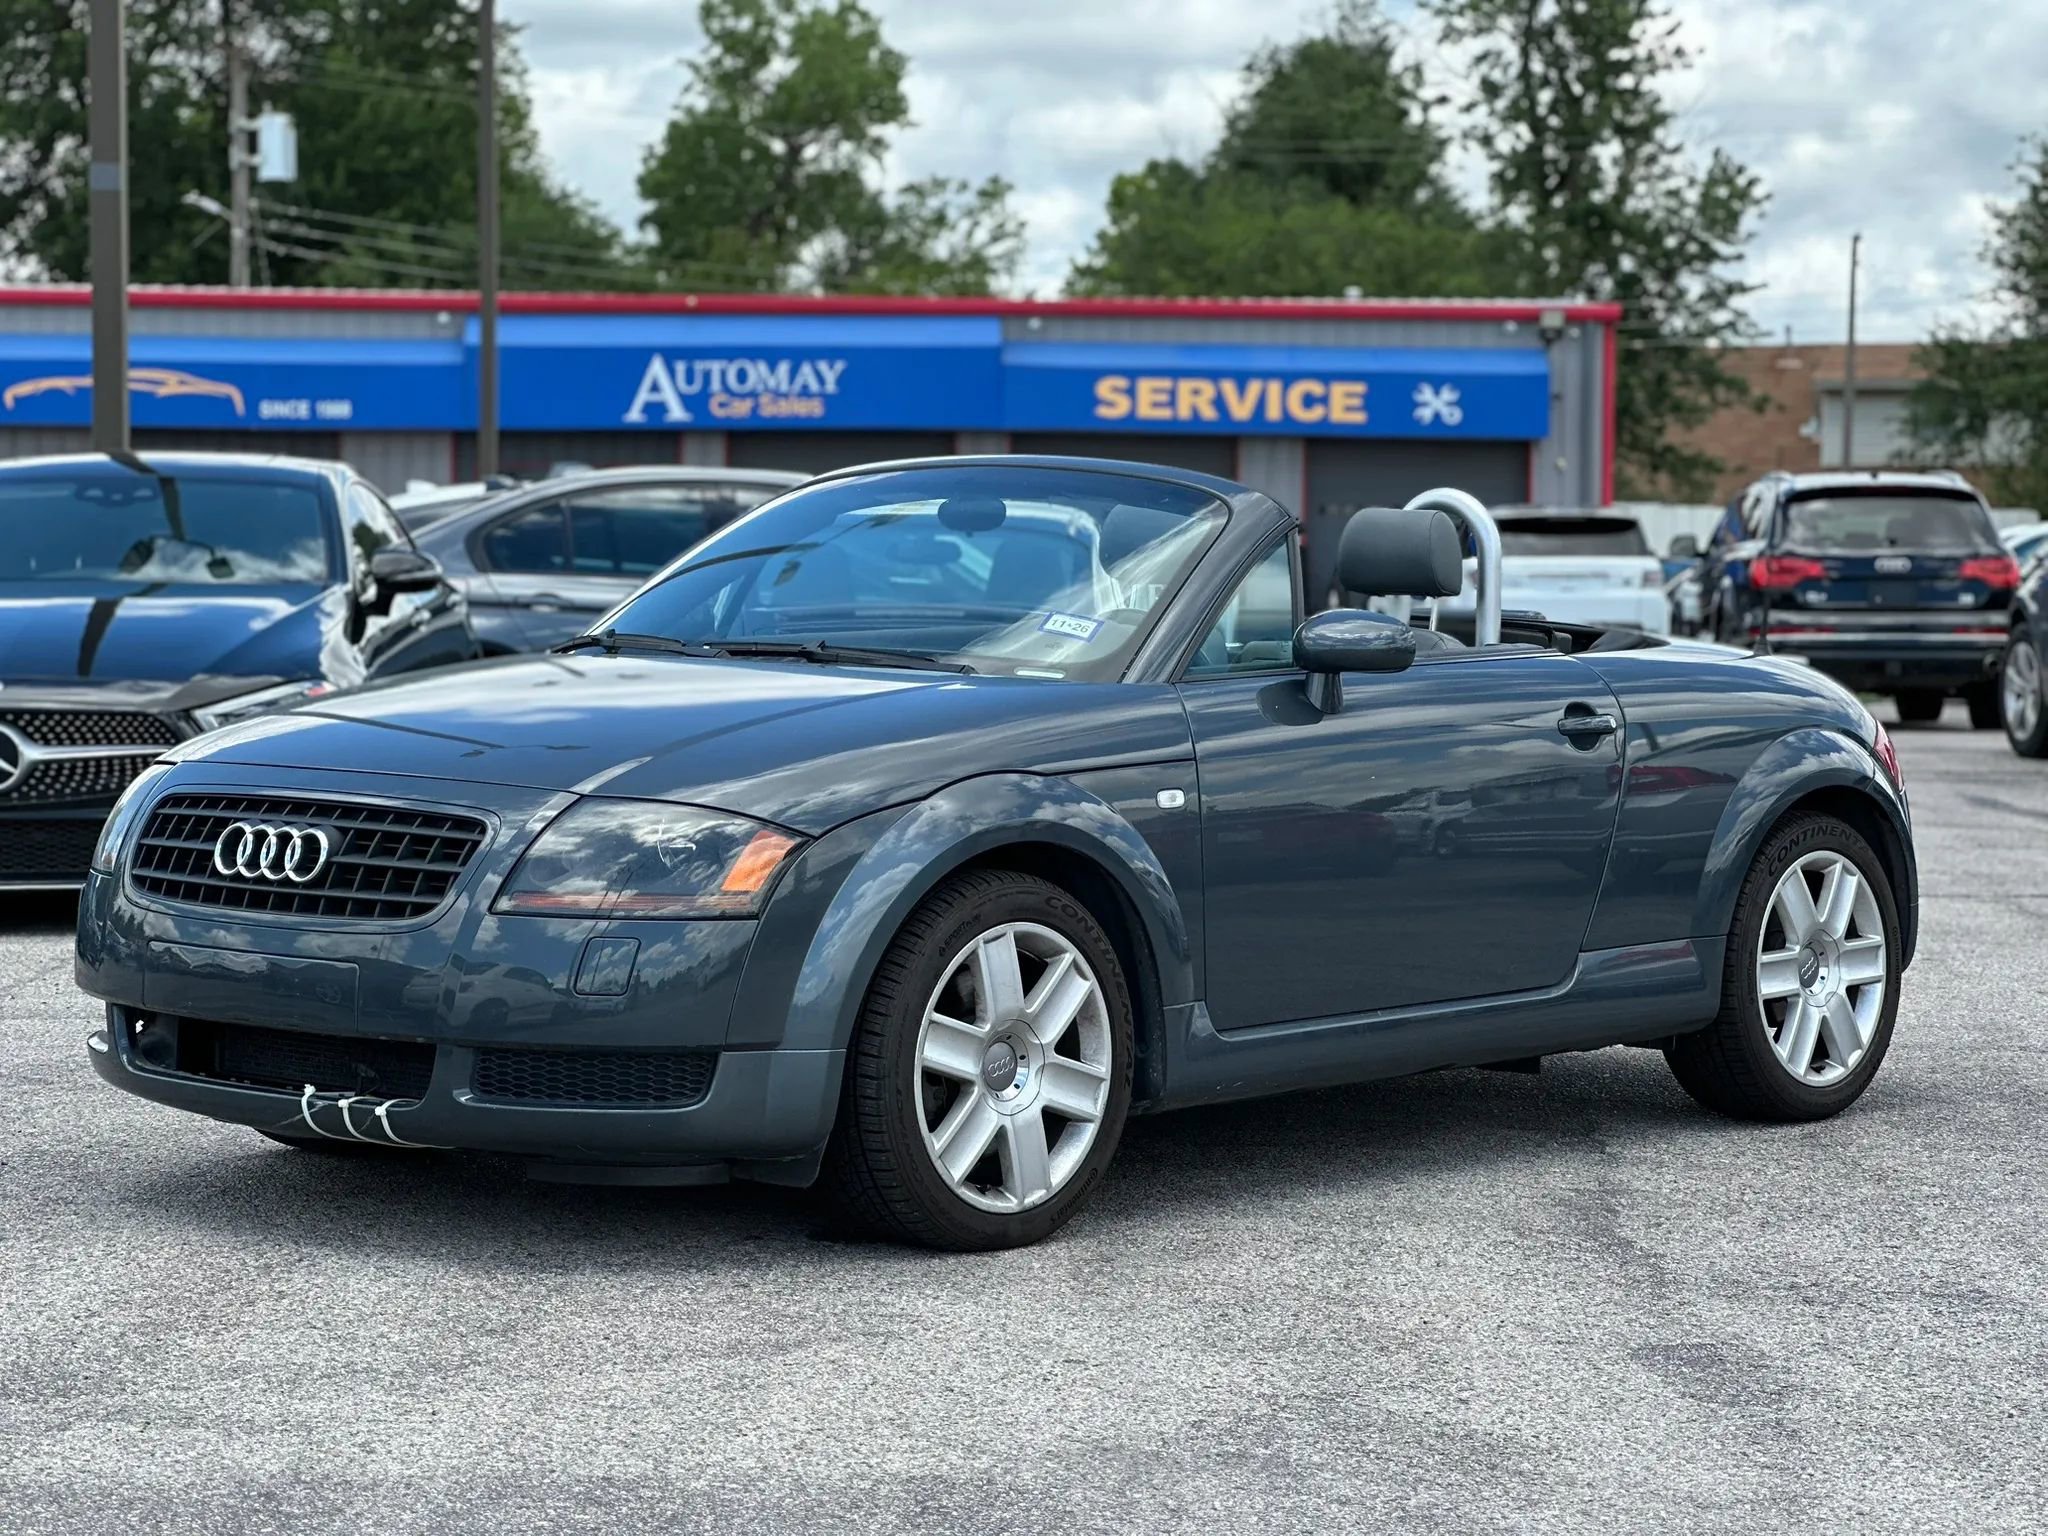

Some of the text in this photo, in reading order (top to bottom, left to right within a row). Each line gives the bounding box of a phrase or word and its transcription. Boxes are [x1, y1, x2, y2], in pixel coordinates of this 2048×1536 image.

[622, 352, 847, 423] AUTOMAY
[708, 392, 826, 418] Car Sales
[1094, 375, 1368, 424] SERVICE
[258, 398, 312, 420] SINCE
